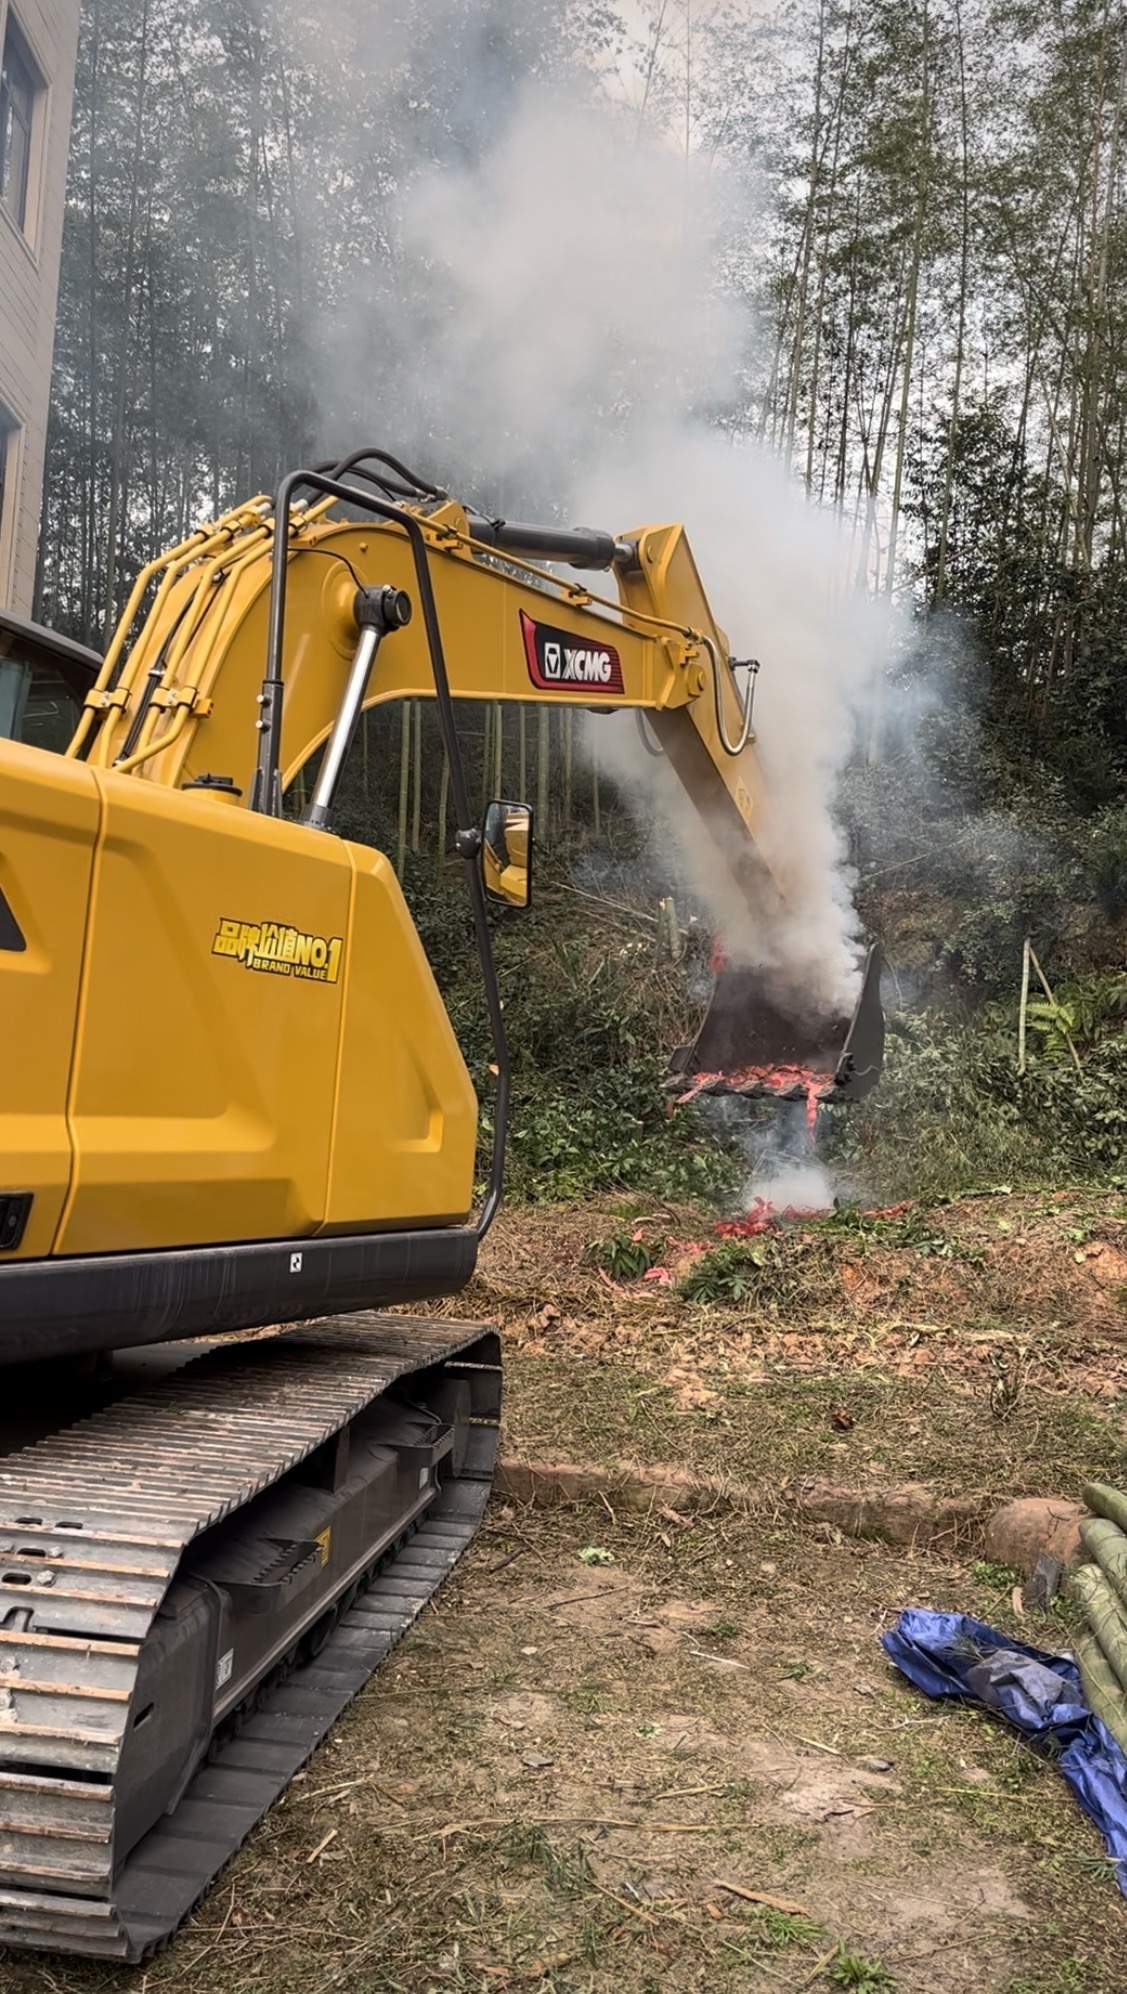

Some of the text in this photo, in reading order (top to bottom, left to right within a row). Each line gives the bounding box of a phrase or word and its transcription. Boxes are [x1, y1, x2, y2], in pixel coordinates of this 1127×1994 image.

[562, 649, 611, 682] XCMG
[253, 958, 327, 980] BRAND VALUE
